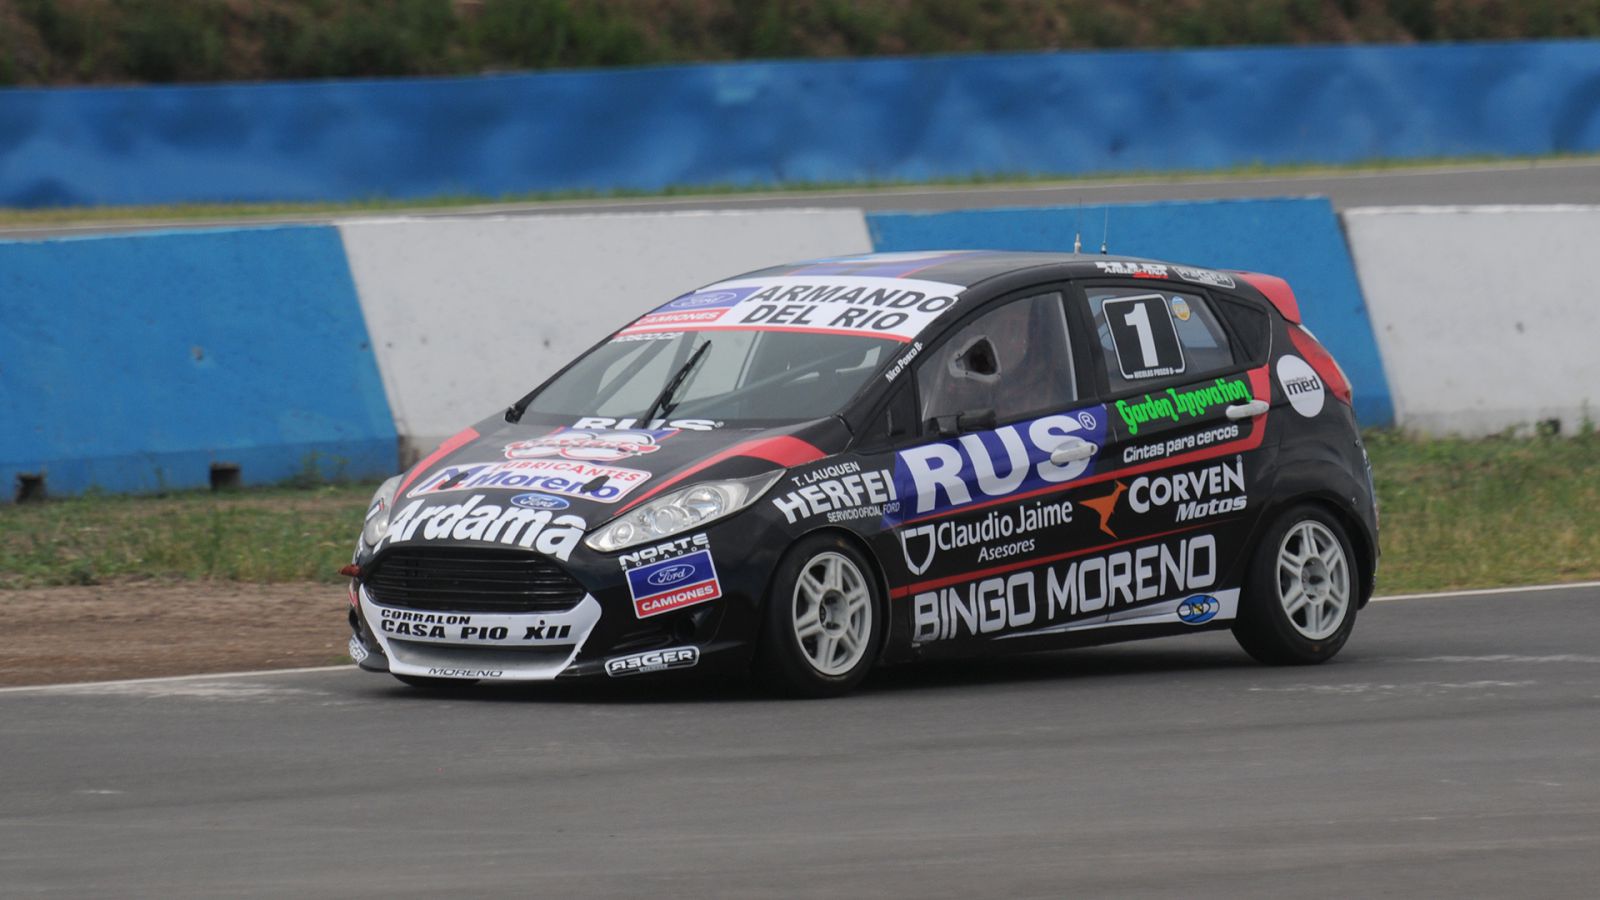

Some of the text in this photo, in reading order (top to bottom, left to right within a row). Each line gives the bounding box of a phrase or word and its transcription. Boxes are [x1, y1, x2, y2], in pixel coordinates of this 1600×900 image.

[743, 285, 955, 312] ARMANDO
[739, 304, 910, 331] DEL RIO
[1124, 302, 1159, 367] 1
[1286, 375, 1321, 395] med
[1115, 378, 1252, 435] Garden Innovation
[1123, 425, 1239, 463] Cintas para cercos
[791, 461, 861, 487] T. LAUQUEN
[1128, 461, 1246, 514] CORVEN
[520, 495, 559, 508] Ford
[772, 469, 897, 524] HERFEI
[1175, 495, 1248, 523] Motos
[827, 502, 900, 523] SERVICIO OFICIAL FORD
[937, 501, 1073, 550] Claudio Jaime
[374, 495, 587, 562] Ardama
[618, 532, 709, 566] NORTE
[978, 537, 1035, 563] Asesores
[657, 567, 686, 583] Ford
[913, 534, 1217, 642] BINGO MORENO
[641, 585, 714, 611] CAMIONES
[381, 609, 471, 625] CORRALON
[381, 619, 446, 639] CASA
[460, 626, 508, 641] PIO
[428, 667, 503, 678] MORENO
